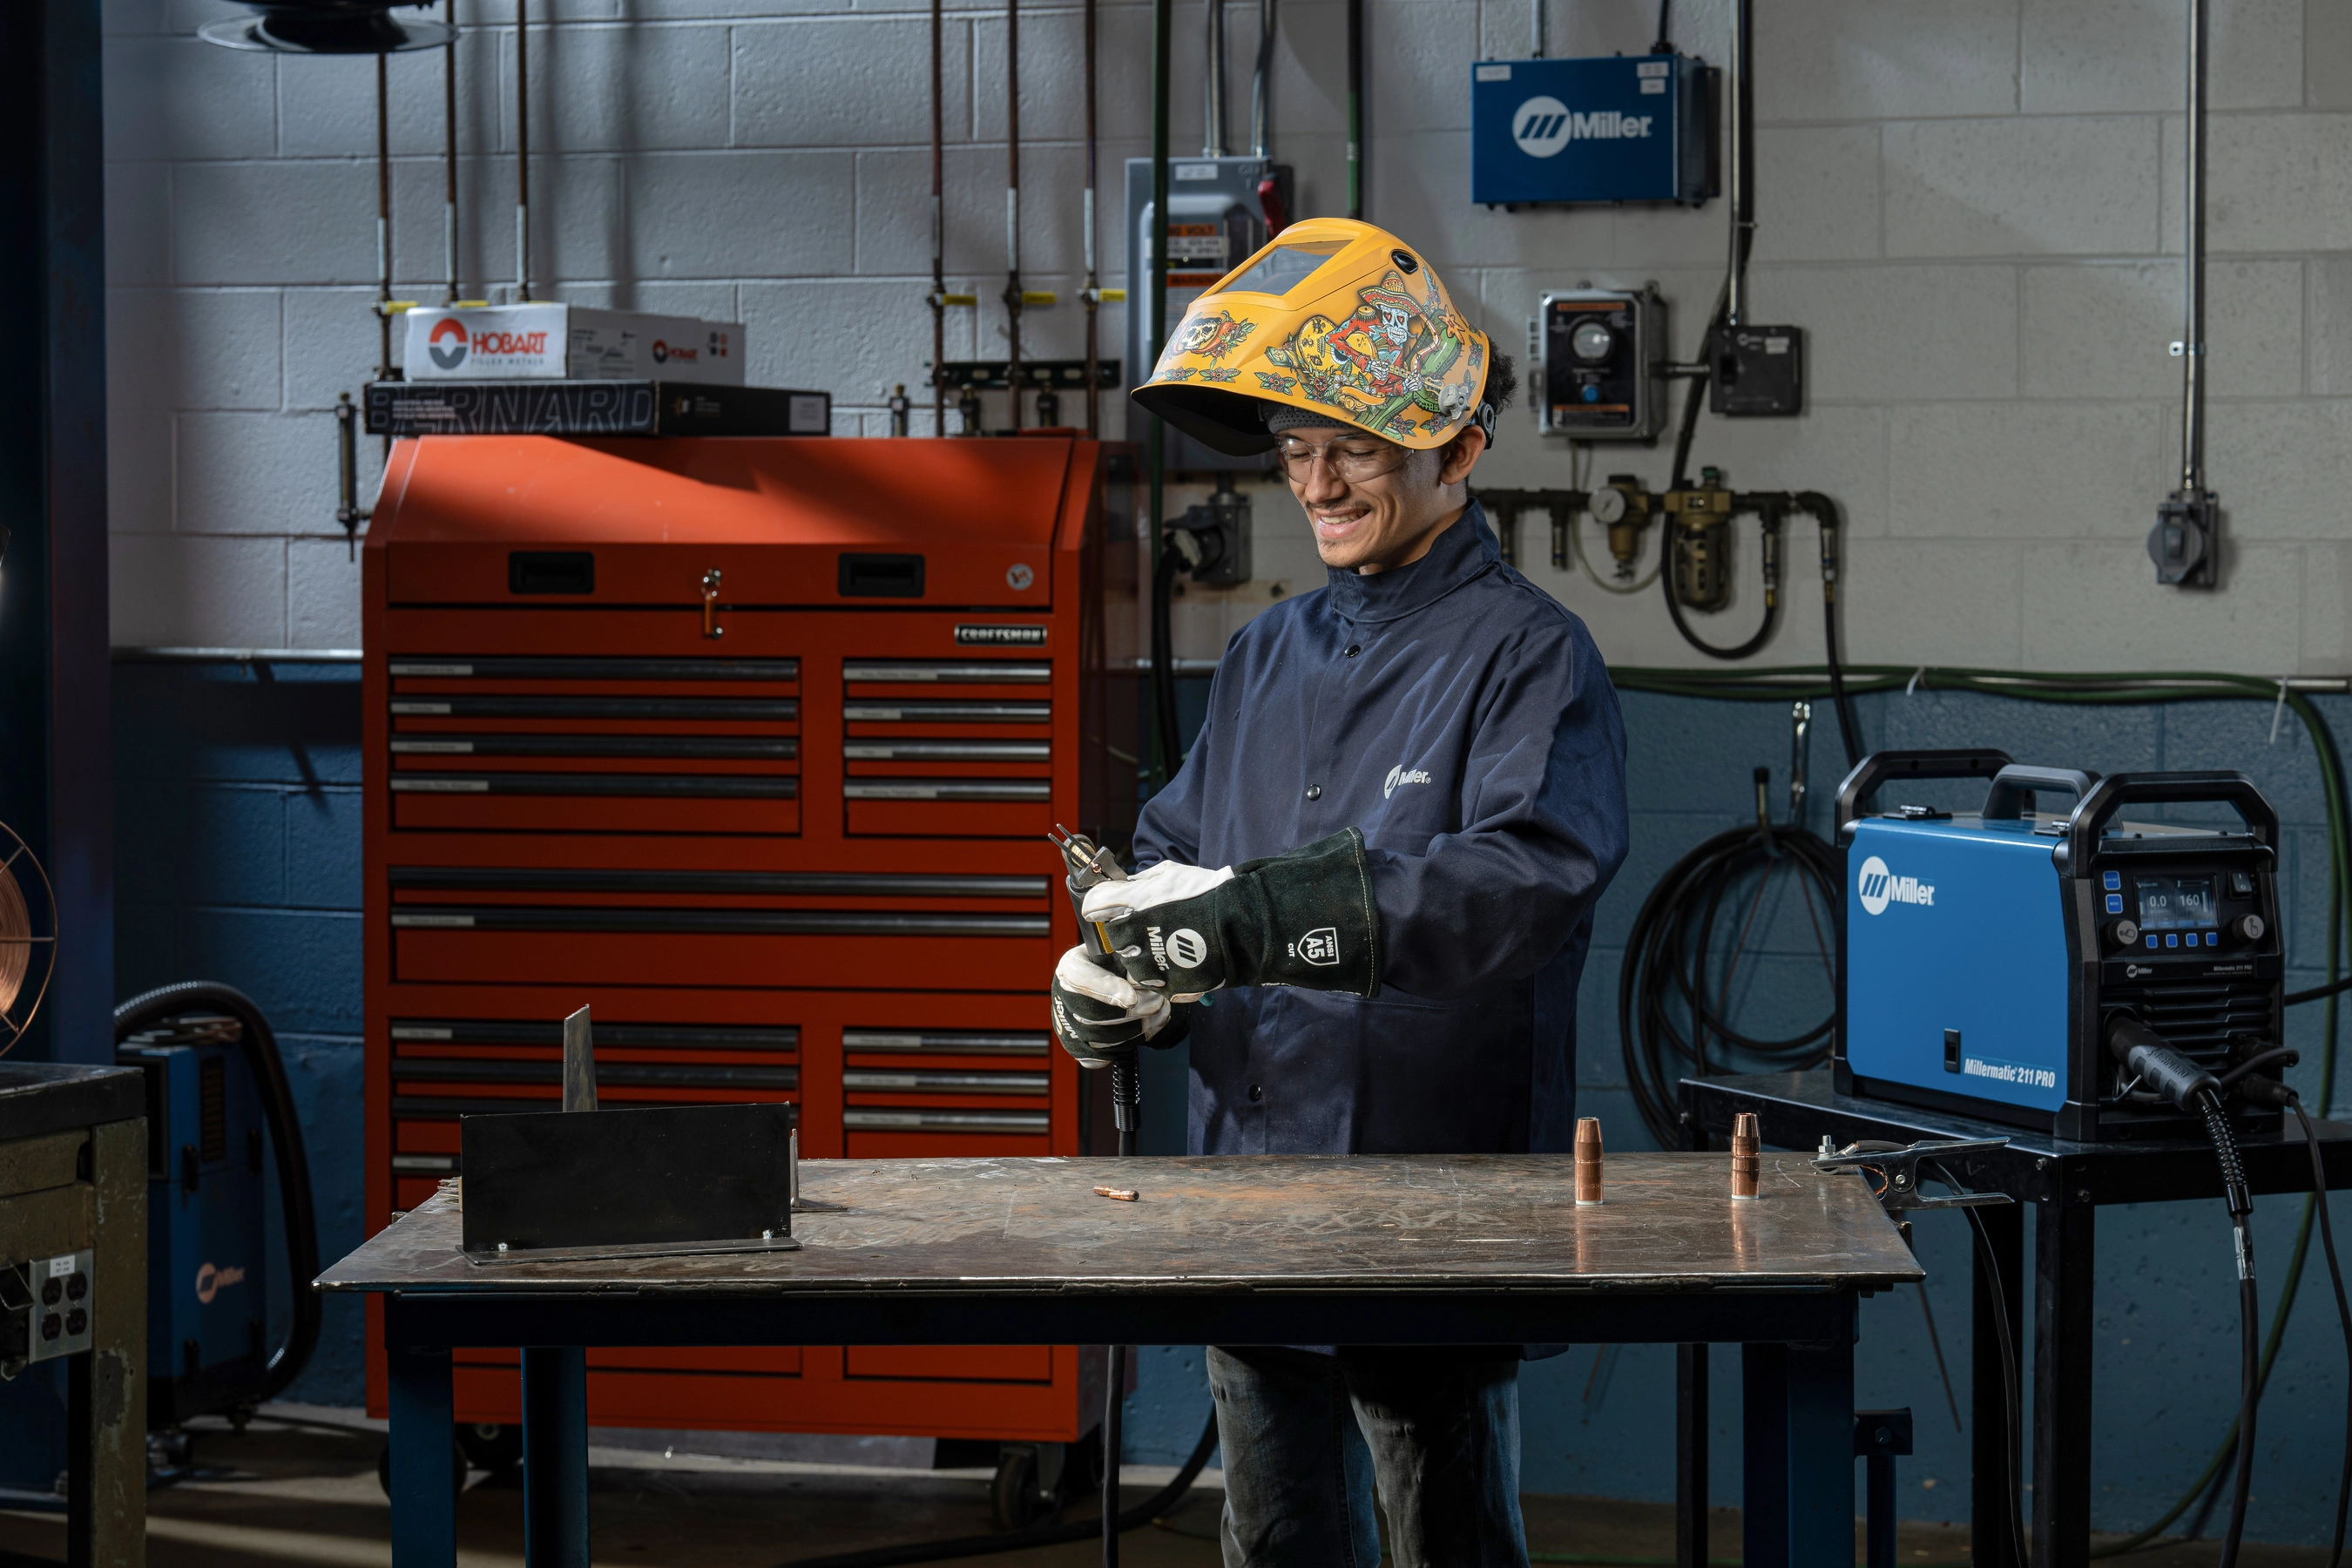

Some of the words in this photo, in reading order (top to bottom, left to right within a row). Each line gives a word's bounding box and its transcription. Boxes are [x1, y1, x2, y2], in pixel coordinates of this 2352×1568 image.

[1572, 111, 1652, 139] Miller
[472, 332, 548, 355] HOBART
[1891, 875, 1935, 906] Miller
[2149, 895, 2166, 907] 0.0
[2180, 894, 2200, 907] 160
[1146, 926, 1170, 970] Miller
[1306, 937, 1325, 959] A5
[1325, 935, 1335, 957] ANSI
[1054, 996, 1079, 1039] Miller
[1964, 1058, 2017, 1082] Millermatic
[2017, 1067, 2035, 1085] 211
[2035, 1070, 2056, 1089] PRO
